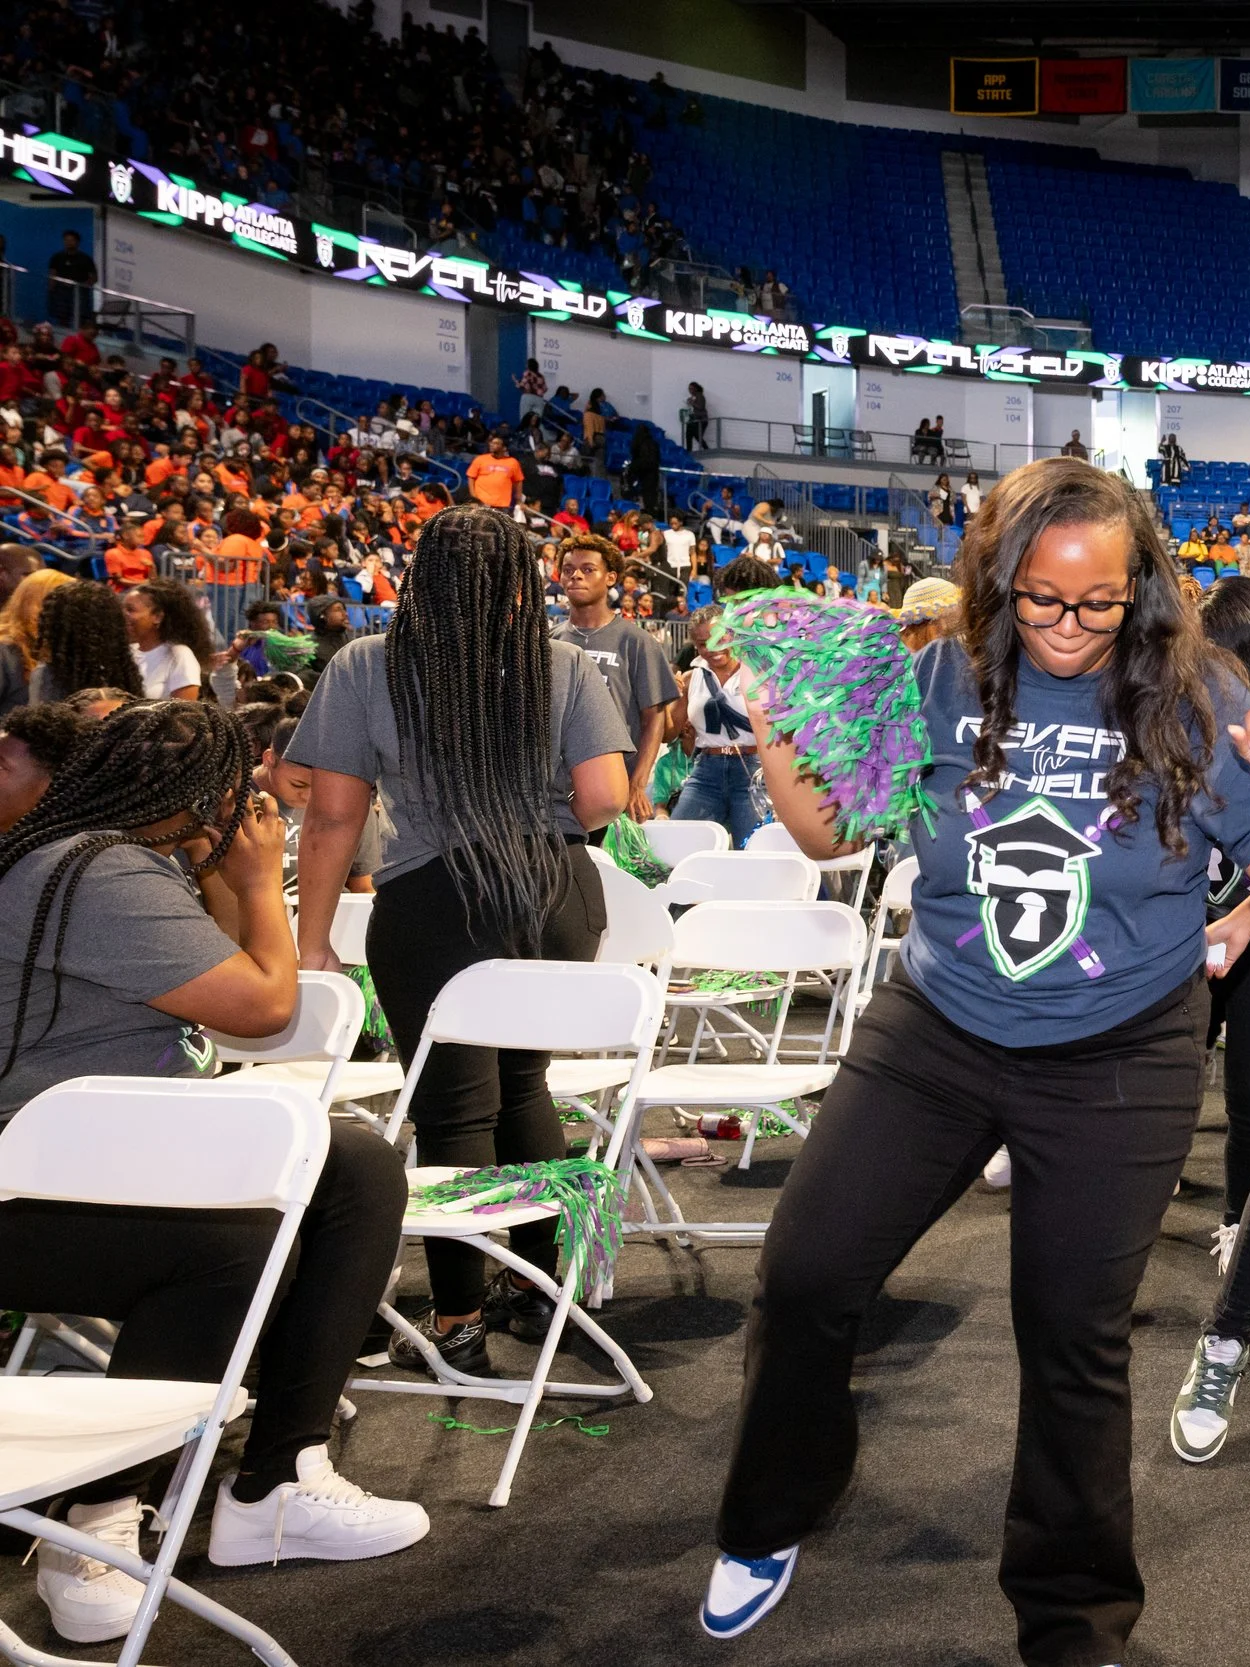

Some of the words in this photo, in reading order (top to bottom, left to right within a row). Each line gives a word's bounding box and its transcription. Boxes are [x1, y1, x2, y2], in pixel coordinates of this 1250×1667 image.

[983, 74, 1007, 86] APP
[977, 89, 1013, 101] STATE
[0, 128, 87, 181] HIELD
[235, 205, 297, 239] ATLANTA
[235, 223, 298, 254] COLLEGIATE
[358, 241, 494, 296] REVEAL
[489, 271, 521, 303] the
[519, 281, 607, 318] SHIELD
[439, 319, 457, 331] 205
[743, 320, 807, 340] ATLANTA
[439, 342, 456, 353] 103
[543, 338, 560, 349] 205
[743, 332, 809, 352] COLLEGIATE
[869, 334, 978, 369] REVEAL
[973, 349, 1002, 374] the
[1000, 354, 1084, 377] SHIELD
[543, 359, 559, 370] 103
[776, 372, 792, 382] 206
[866, 383, 882, 393] 206
[866, 401, 881, 410] 104
[1005, 396, 1022, 405] 206
[1166, 405, 1181, 414] 207
[1006, 414, 1020, 423] 104
[1166, 422, 1181, 431] 105
[1024, 744, 1070, 775] the
